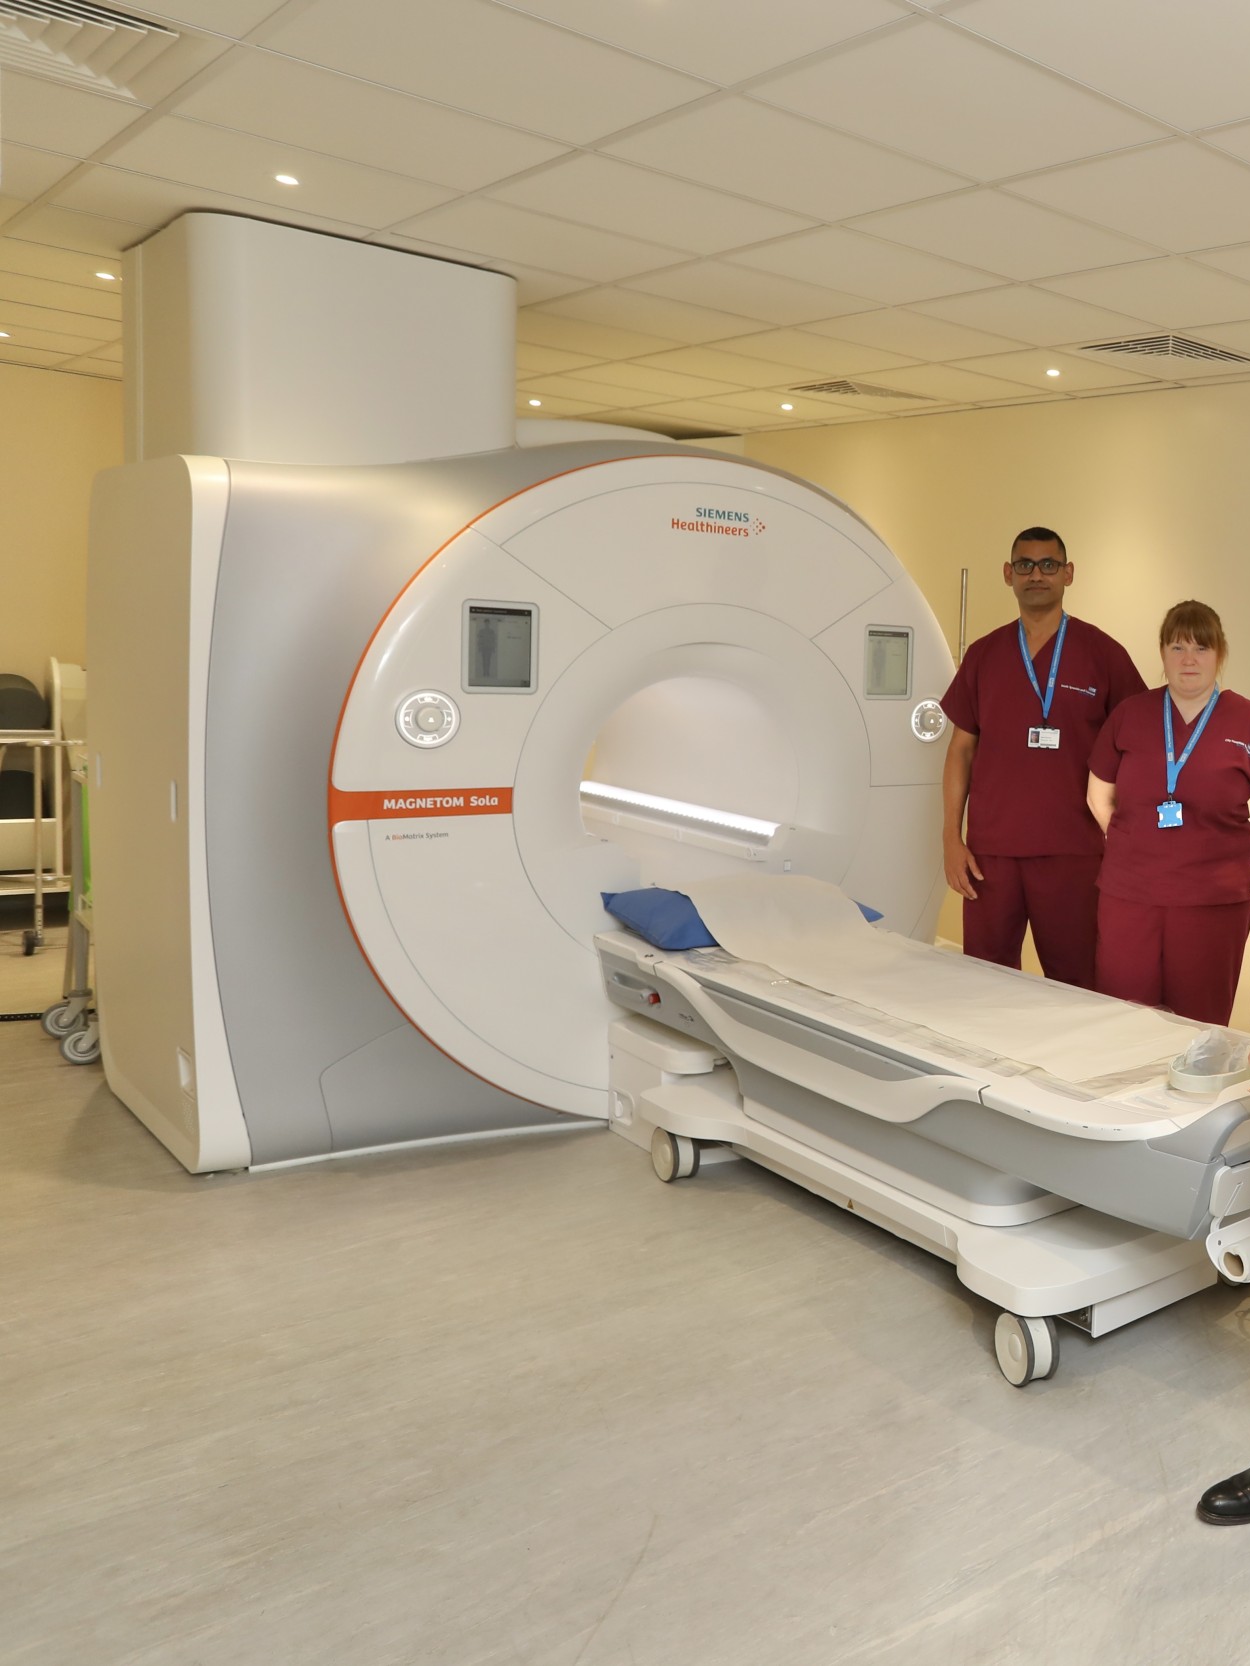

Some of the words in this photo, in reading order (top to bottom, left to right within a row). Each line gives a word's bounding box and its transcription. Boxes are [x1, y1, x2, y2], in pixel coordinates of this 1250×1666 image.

[696, 507, 749, 523] SIEMENS
[671, 518, 749, 537] Healthineers
[383, 796, 464, 810] MAGNETOM
[469, 795, 498, 807] Sola
[392, 832, 424, 841] BioMatrix
[425, 831, 449, 840] System
